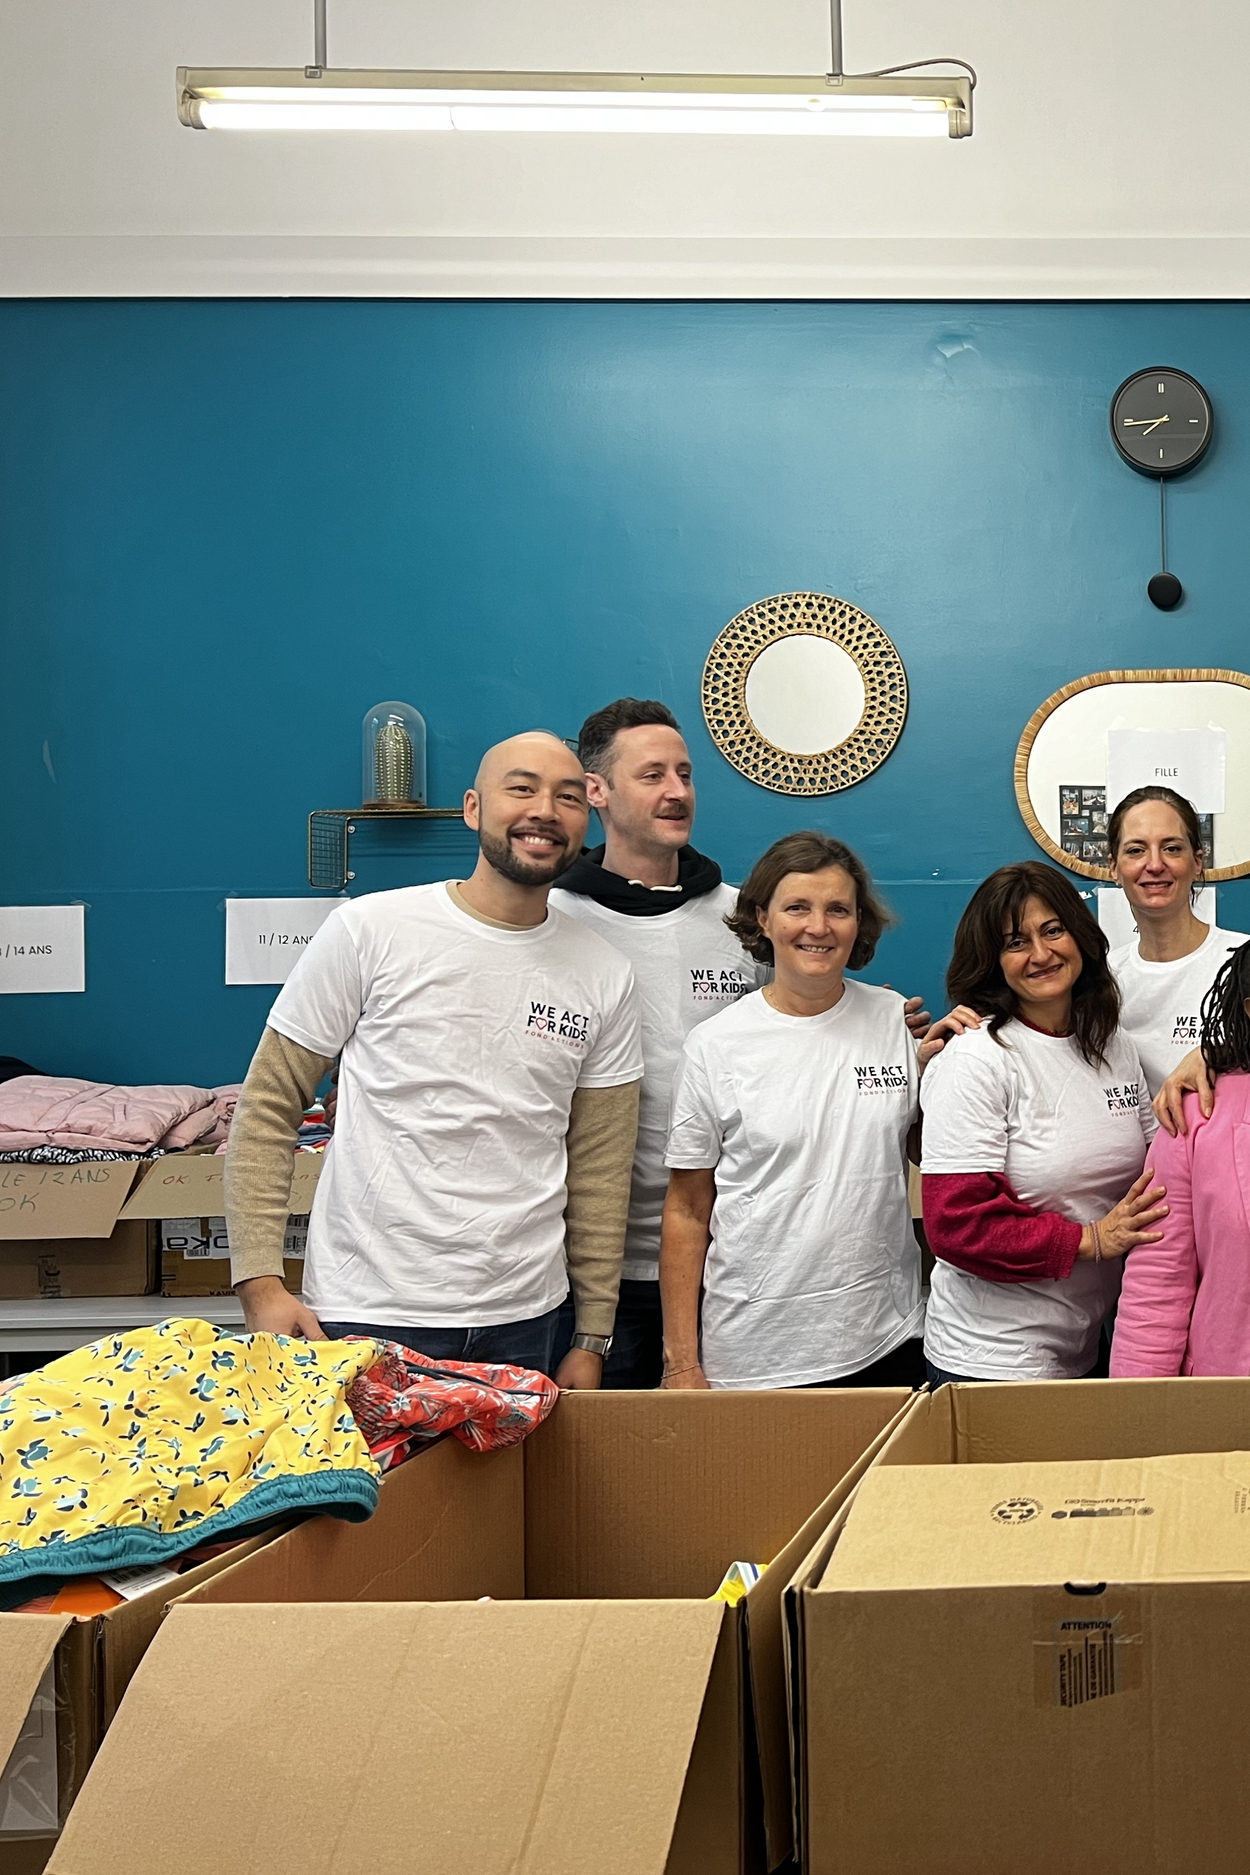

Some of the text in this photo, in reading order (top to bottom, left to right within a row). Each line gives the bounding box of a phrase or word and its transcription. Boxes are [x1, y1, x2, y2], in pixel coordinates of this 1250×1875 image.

[1154, 767, 1179, 777] FILLE
[258, 934, 266, 944] 11
[269, 932, 274, 946] /
[278, 934, 289, 944] 12
[5, 944, 10, 958] /
[14, 946, 25, 956] 14
[28, 944, 52, 955] ANS
[690, 970, 742, 982] WE ACT
[721, 982, 746, 994] KIDS
[530, 1001, 589, 1028] WE ACT
[1176, 1016, 1198, 1027] WE
[558, 1024, 588, 1041] KIDS
[854, 1066, 903, 1077] WE ACT
[883, 1076, 908, 1087] KIDS
[1103, 1087, 1121, 1098] WE
[70, 1168, 110, 1184] ANS
[0, 1192, 40, 1212] OK
[1061, 1622, 1112, 1631] ATTENTION
